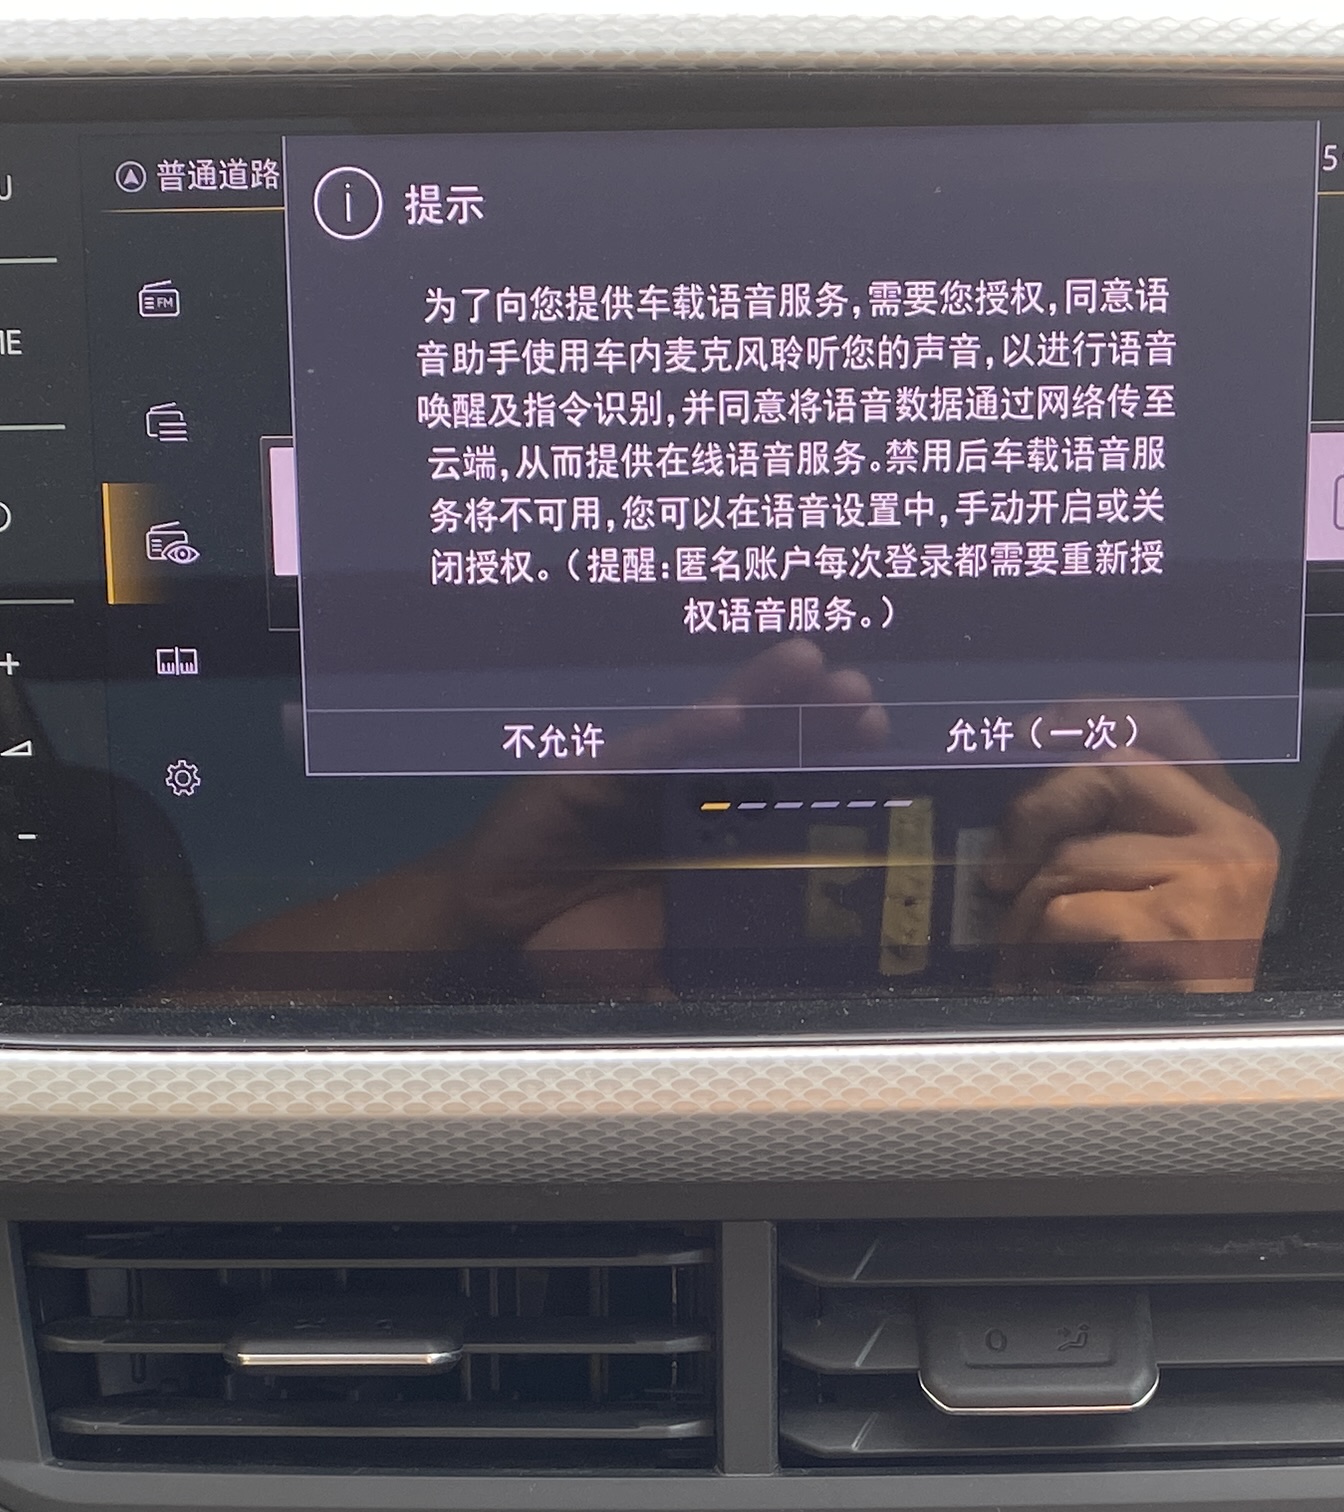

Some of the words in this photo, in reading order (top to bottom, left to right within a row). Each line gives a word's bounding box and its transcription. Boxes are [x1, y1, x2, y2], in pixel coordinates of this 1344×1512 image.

[157, 158, 280, 192] 普通道路
[404, 184, 485, 225] 提示
[156, 296, 174, 309] FM
[502, 723, 605, 759] 不允许
[946, 716, 1140, 753] 允许（一次）
